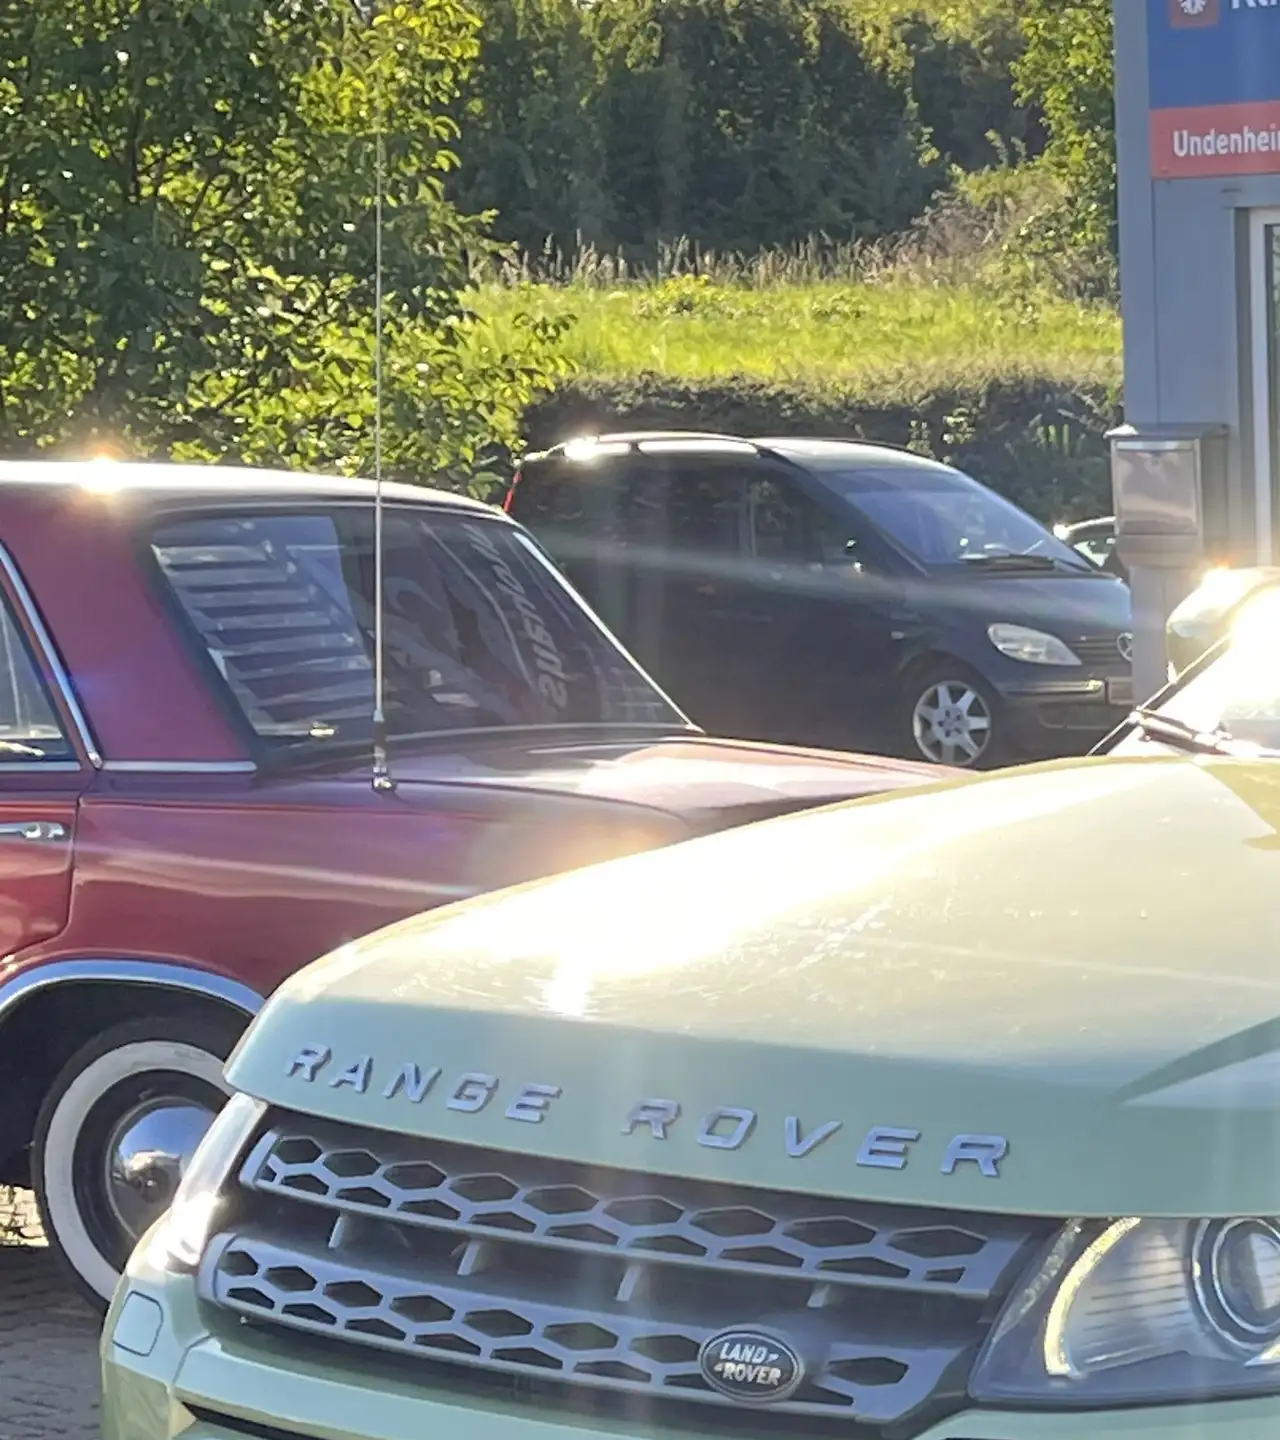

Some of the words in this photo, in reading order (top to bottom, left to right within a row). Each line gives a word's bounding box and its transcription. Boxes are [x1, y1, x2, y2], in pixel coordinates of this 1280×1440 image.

[284, 1041, 562, 1124] RANGE
[620, 1097, 1010, 1177] ROVER
[720, 1342, 768, 1364] LAND
[722, 1361, 782, 1386] ROVER
